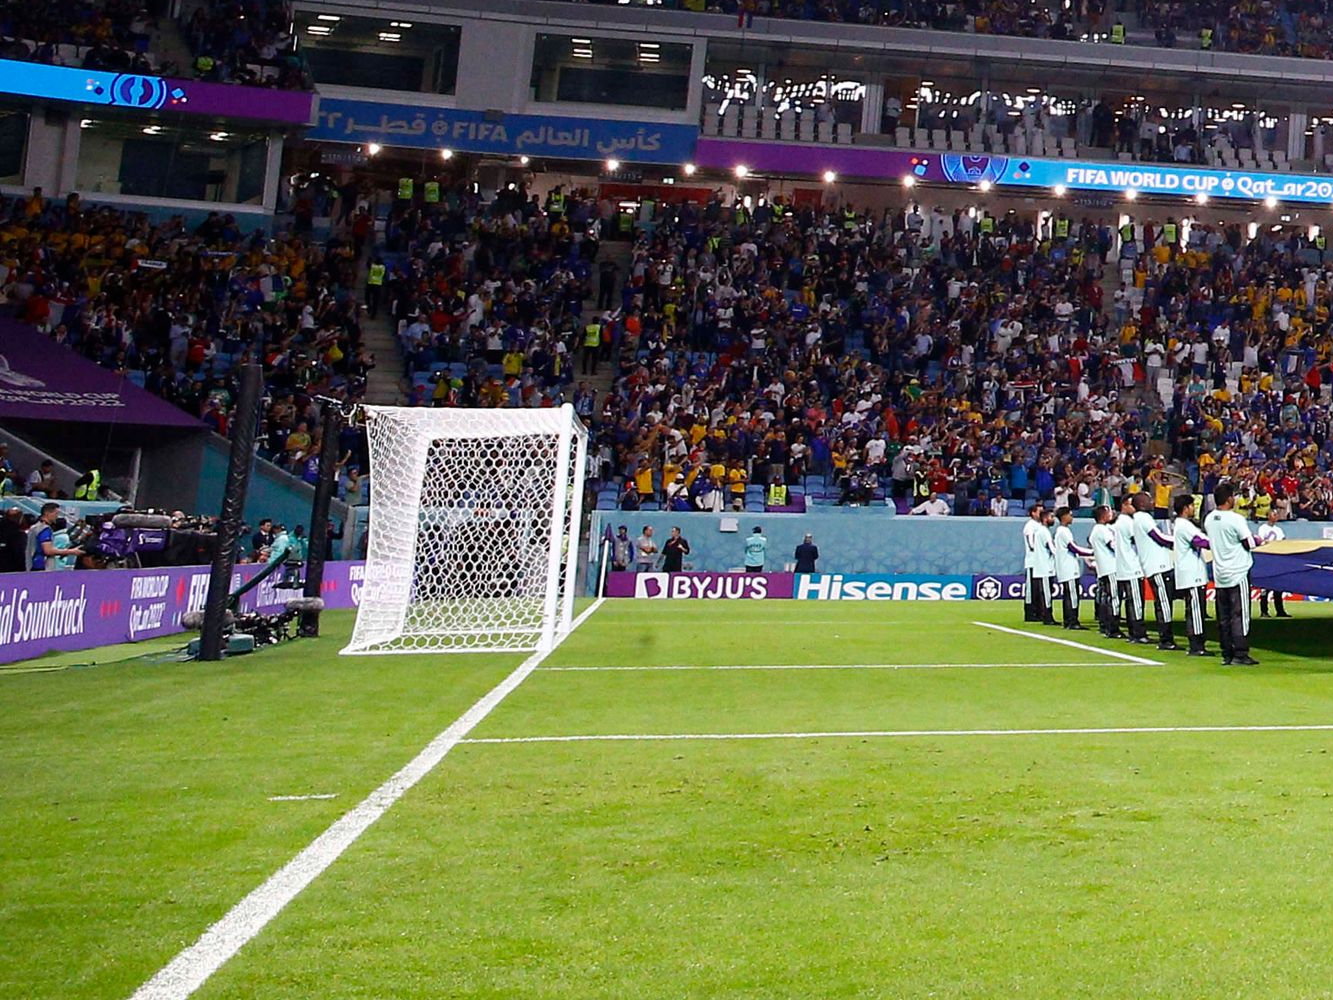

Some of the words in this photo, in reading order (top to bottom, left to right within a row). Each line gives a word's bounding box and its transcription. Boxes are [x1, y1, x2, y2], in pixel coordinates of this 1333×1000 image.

[453, 121, 508, 143] FIFA
[516, 126, 590, 149] العالم
[596, 129, 661, 153] كأس
[1066, 167, 1108, 185] FIFA
[1111, 171, 1179, 190] WORLD
[1182, 174, 1218, 191] CUP
[349, 566, 364, 581] FIFA
[672, 575, 768, 599] BYJU'S
[798, 574, 967, 600] Hisense
[14, 584, 87, 643] Soundtrack
